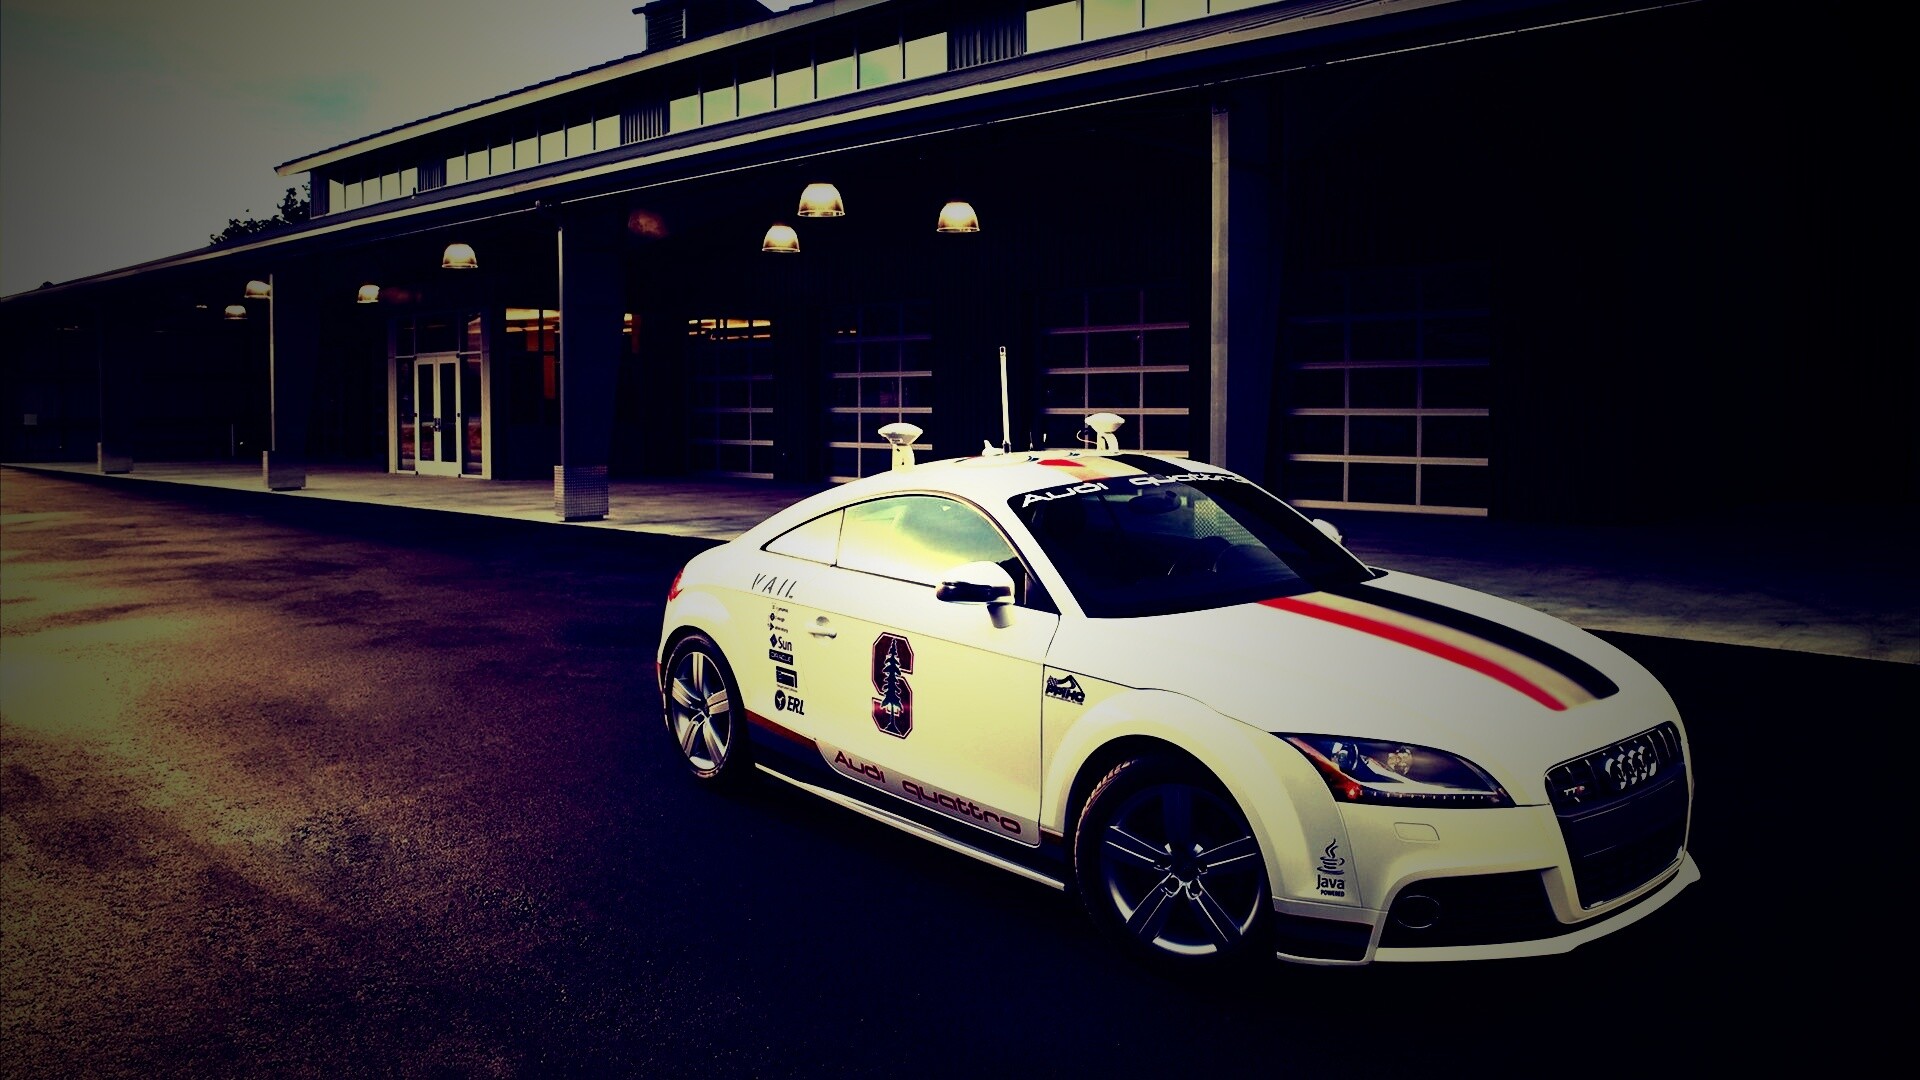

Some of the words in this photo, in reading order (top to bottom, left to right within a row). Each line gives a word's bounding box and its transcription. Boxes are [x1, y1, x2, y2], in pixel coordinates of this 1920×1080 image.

[778, 636, 792, 651] Sun
[787, 695, 804, 715] ERL
[834, 750, 886, 783] Audi
[902, 780, 1021, 834] quattro
[1316, 874, 1345, 890] Java
